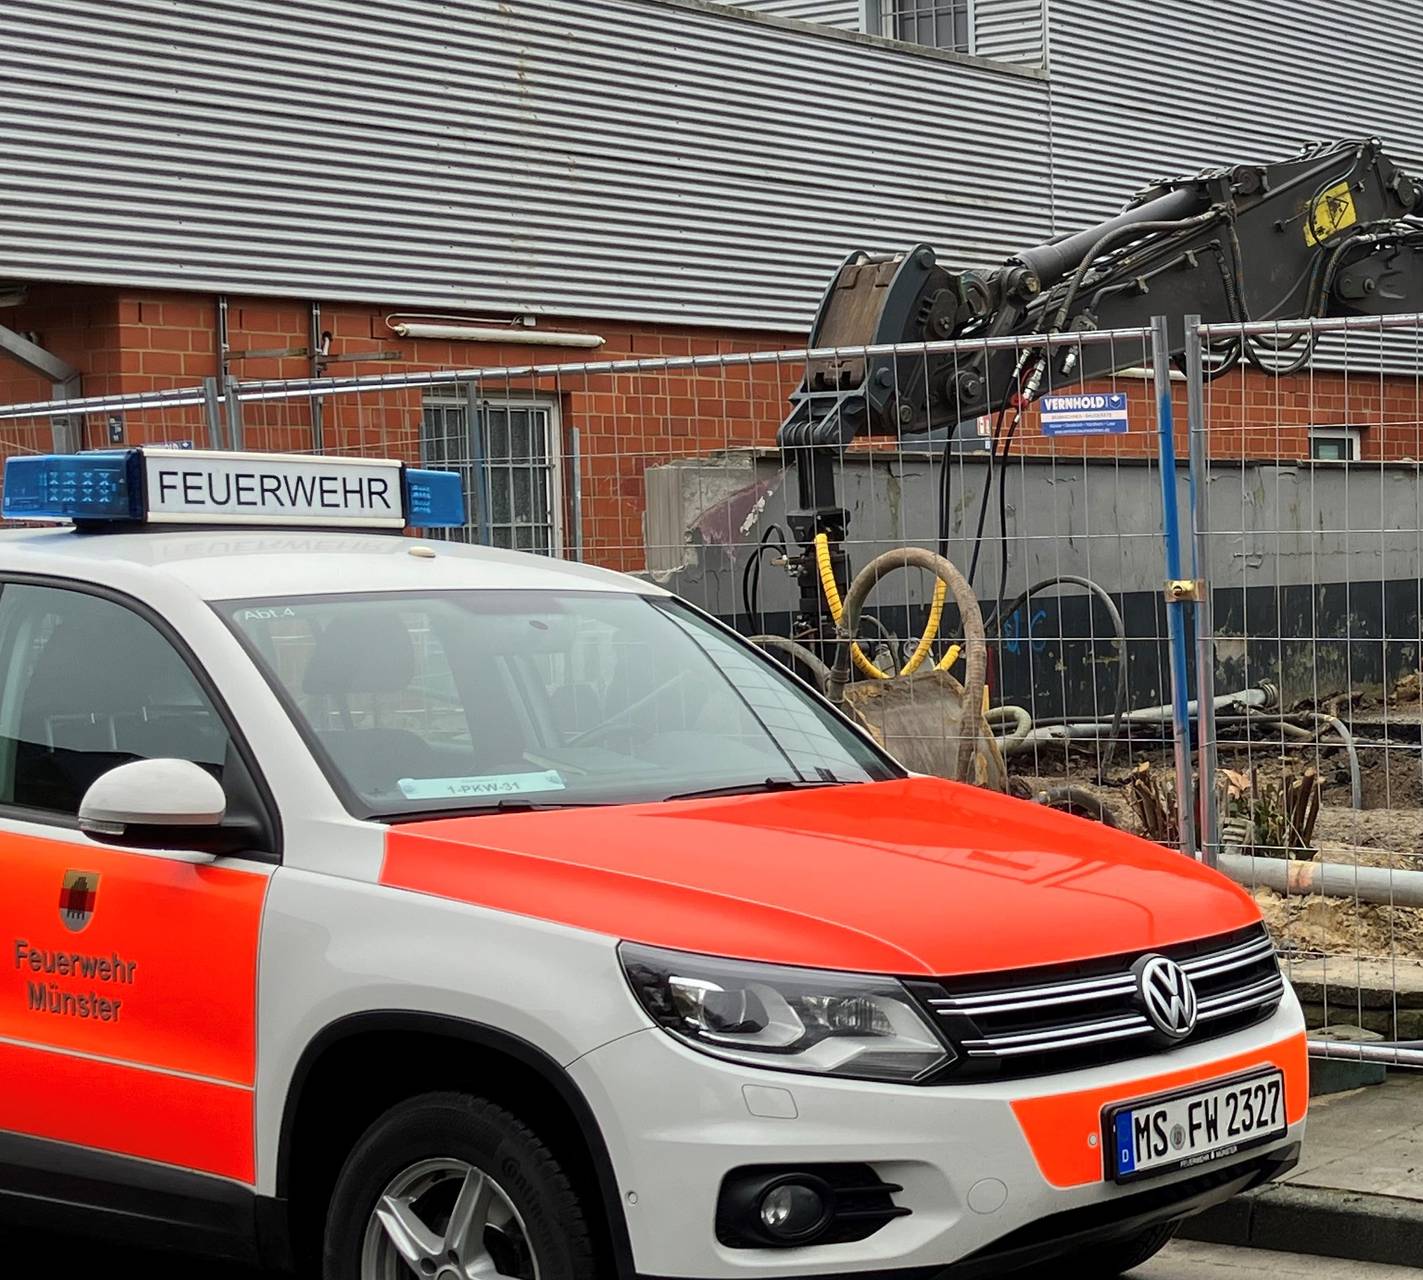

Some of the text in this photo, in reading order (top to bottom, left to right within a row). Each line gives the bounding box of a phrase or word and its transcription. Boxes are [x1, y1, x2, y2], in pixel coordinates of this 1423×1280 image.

[1044, 396, 1105, 411] VERNHOLD
[158, 470, 391, 509] FEUERWEHR
[447, 781, 521, 794] 1-PKW-31
[15, 938, 137, 984] Feuerwehr
[28, 980, 122, 1022] Münster
[1134, 1080, 1281, 1164] MS FW 2327
